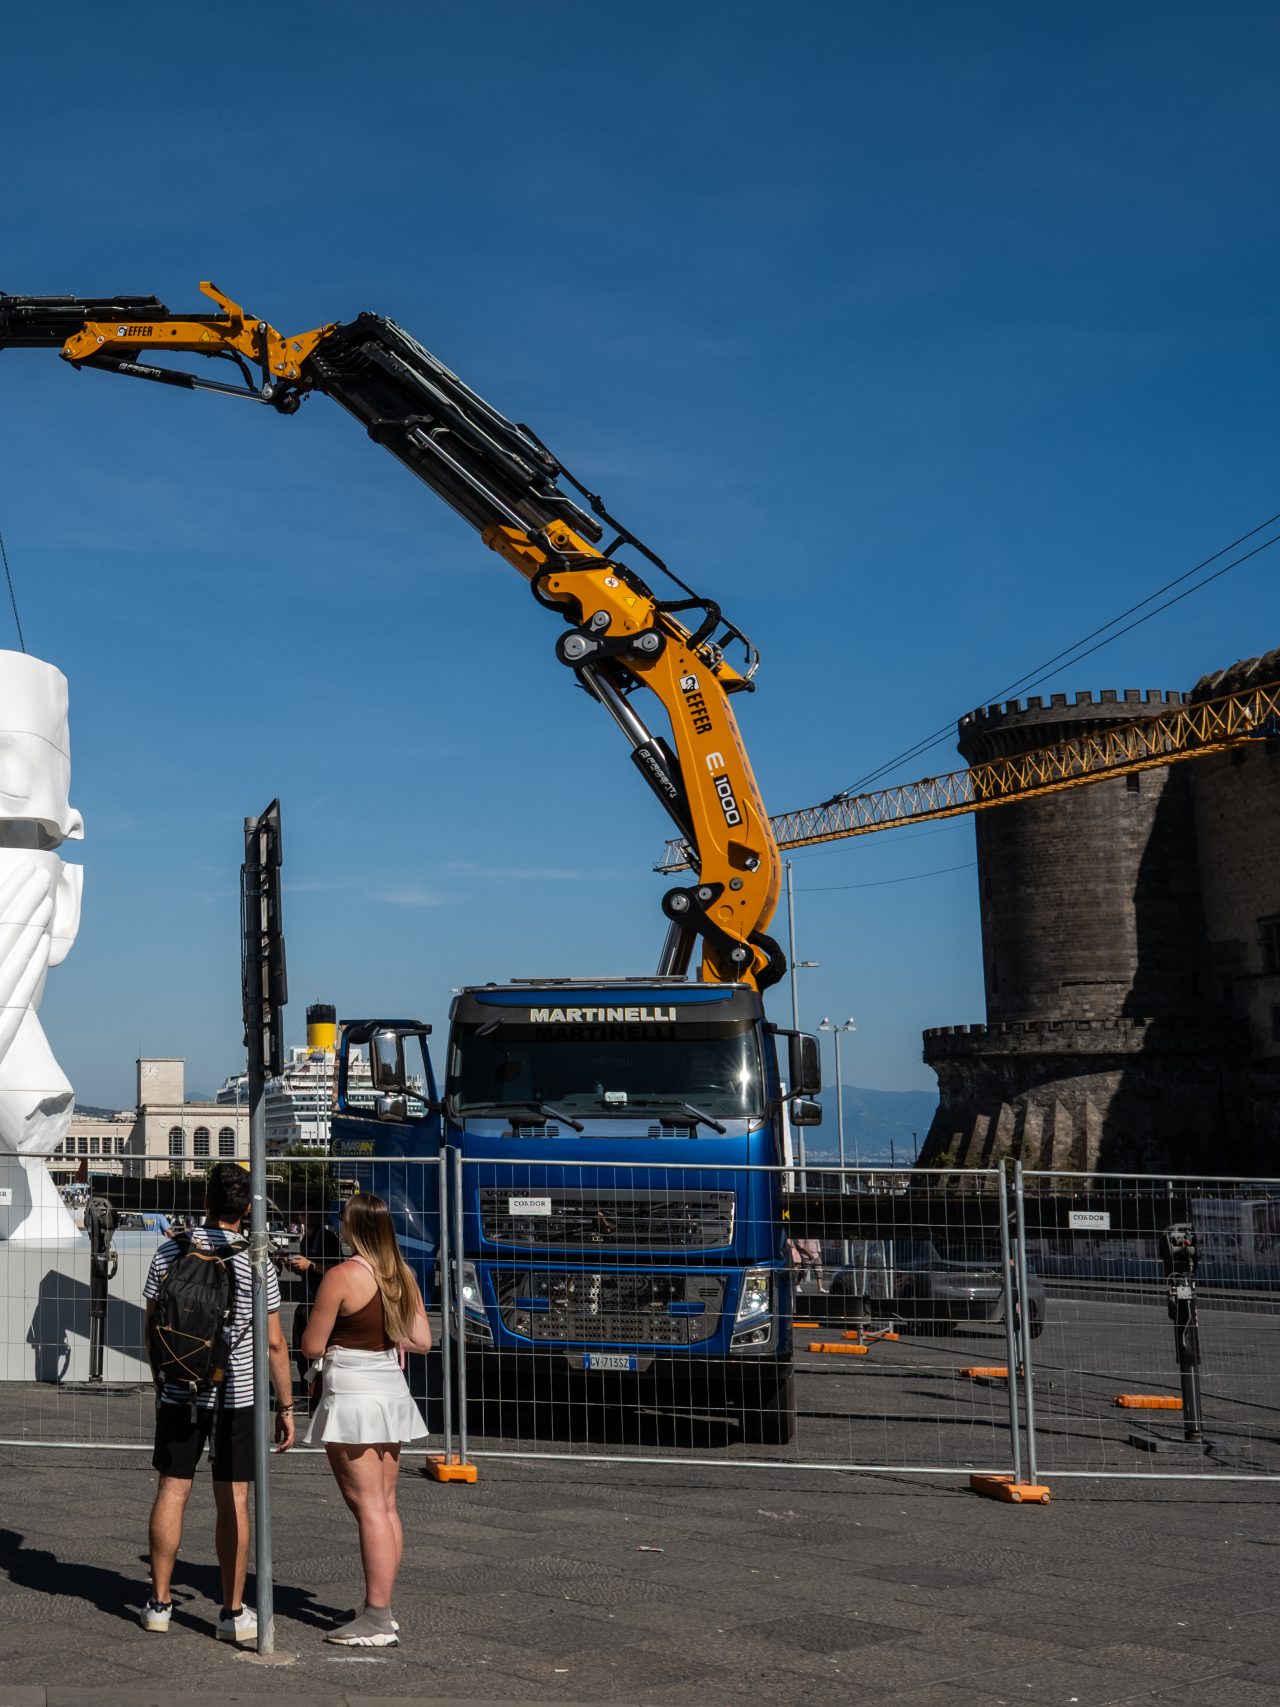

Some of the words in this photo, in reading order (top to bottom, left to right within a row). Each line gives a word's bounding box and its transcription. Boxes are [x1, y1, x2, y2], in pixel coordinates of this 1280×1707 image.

[128, 326, 153, 337] EFFER
[685, 692, 712, 735] EFFER
[530, 1007, 677, 1023] MARTINELLI
